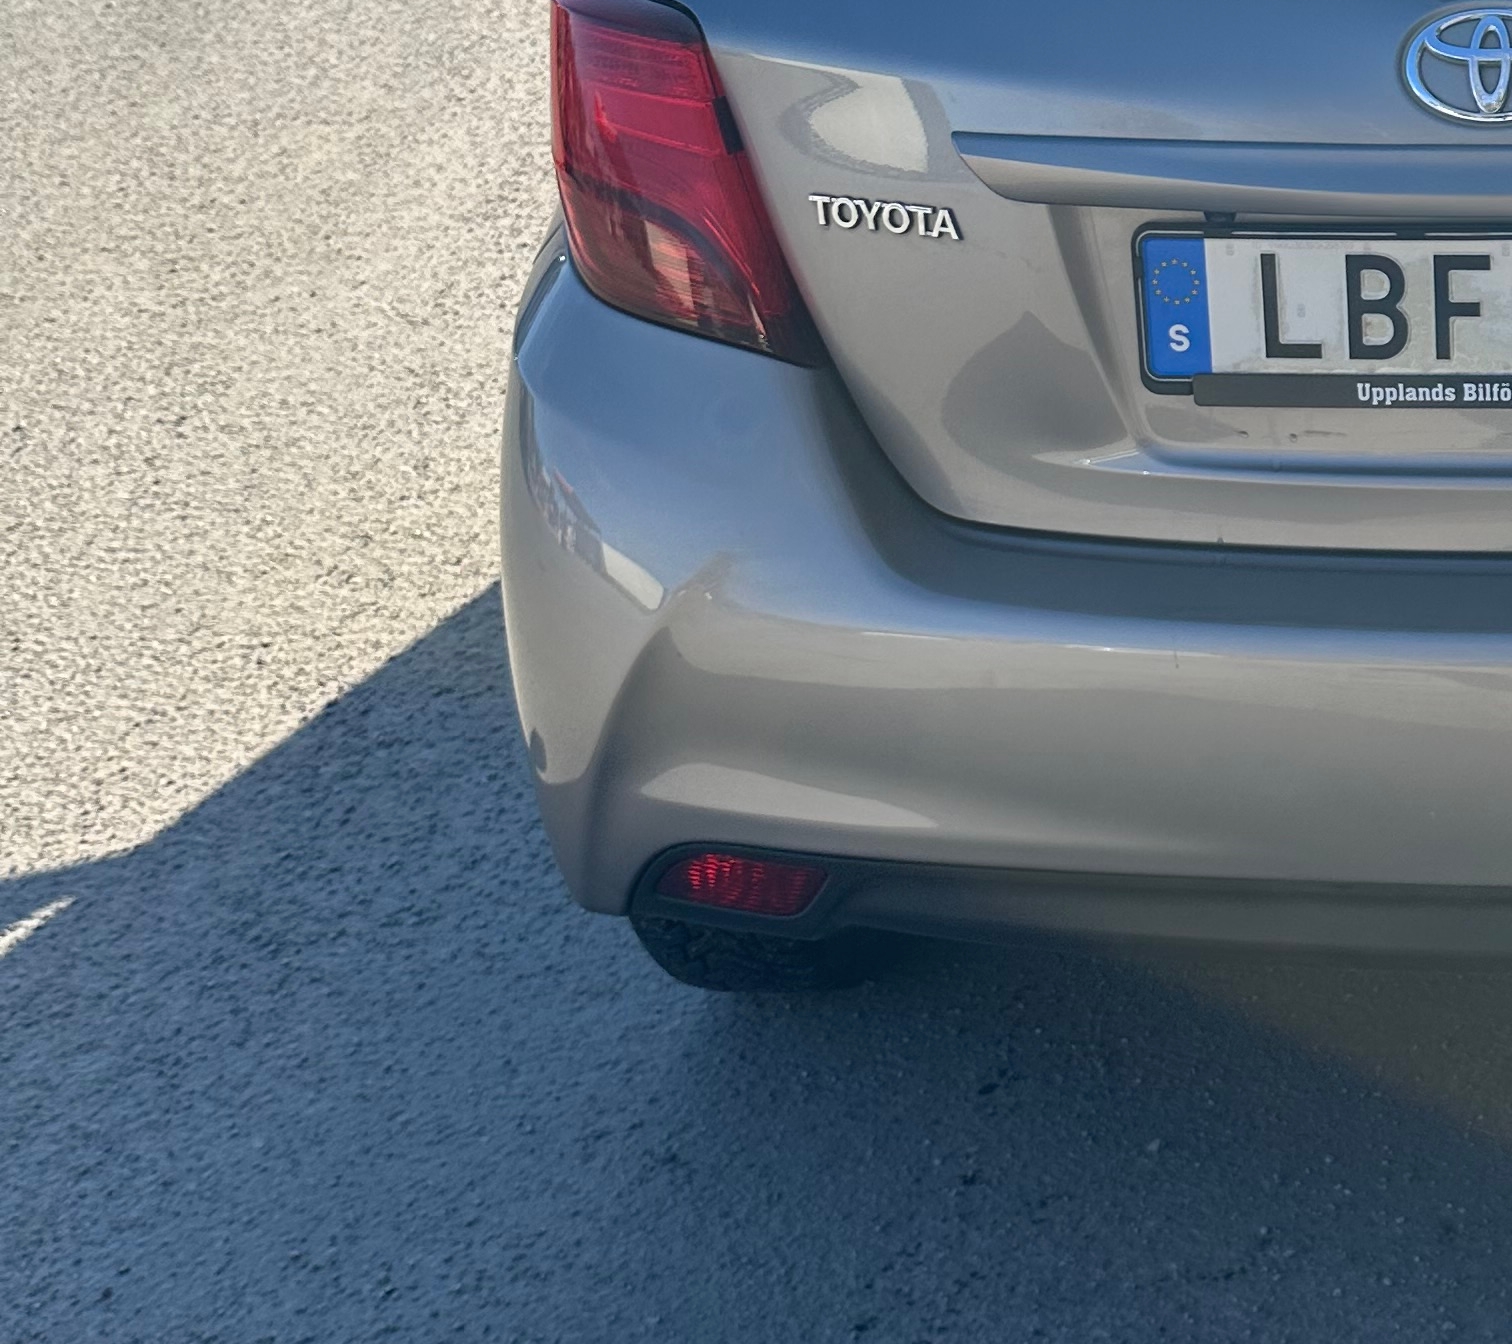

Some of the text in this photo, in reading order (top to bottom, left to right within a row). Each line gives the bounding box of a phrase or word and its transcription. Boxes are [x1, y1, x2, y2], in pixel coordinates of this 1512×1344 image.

[807, 193, 961, 241] TOYOTA
[1260, 252, 1491, 361] LBF
[1168, 323, 1191, 353] S
[1356, 382, 1457, 405] Upplands
